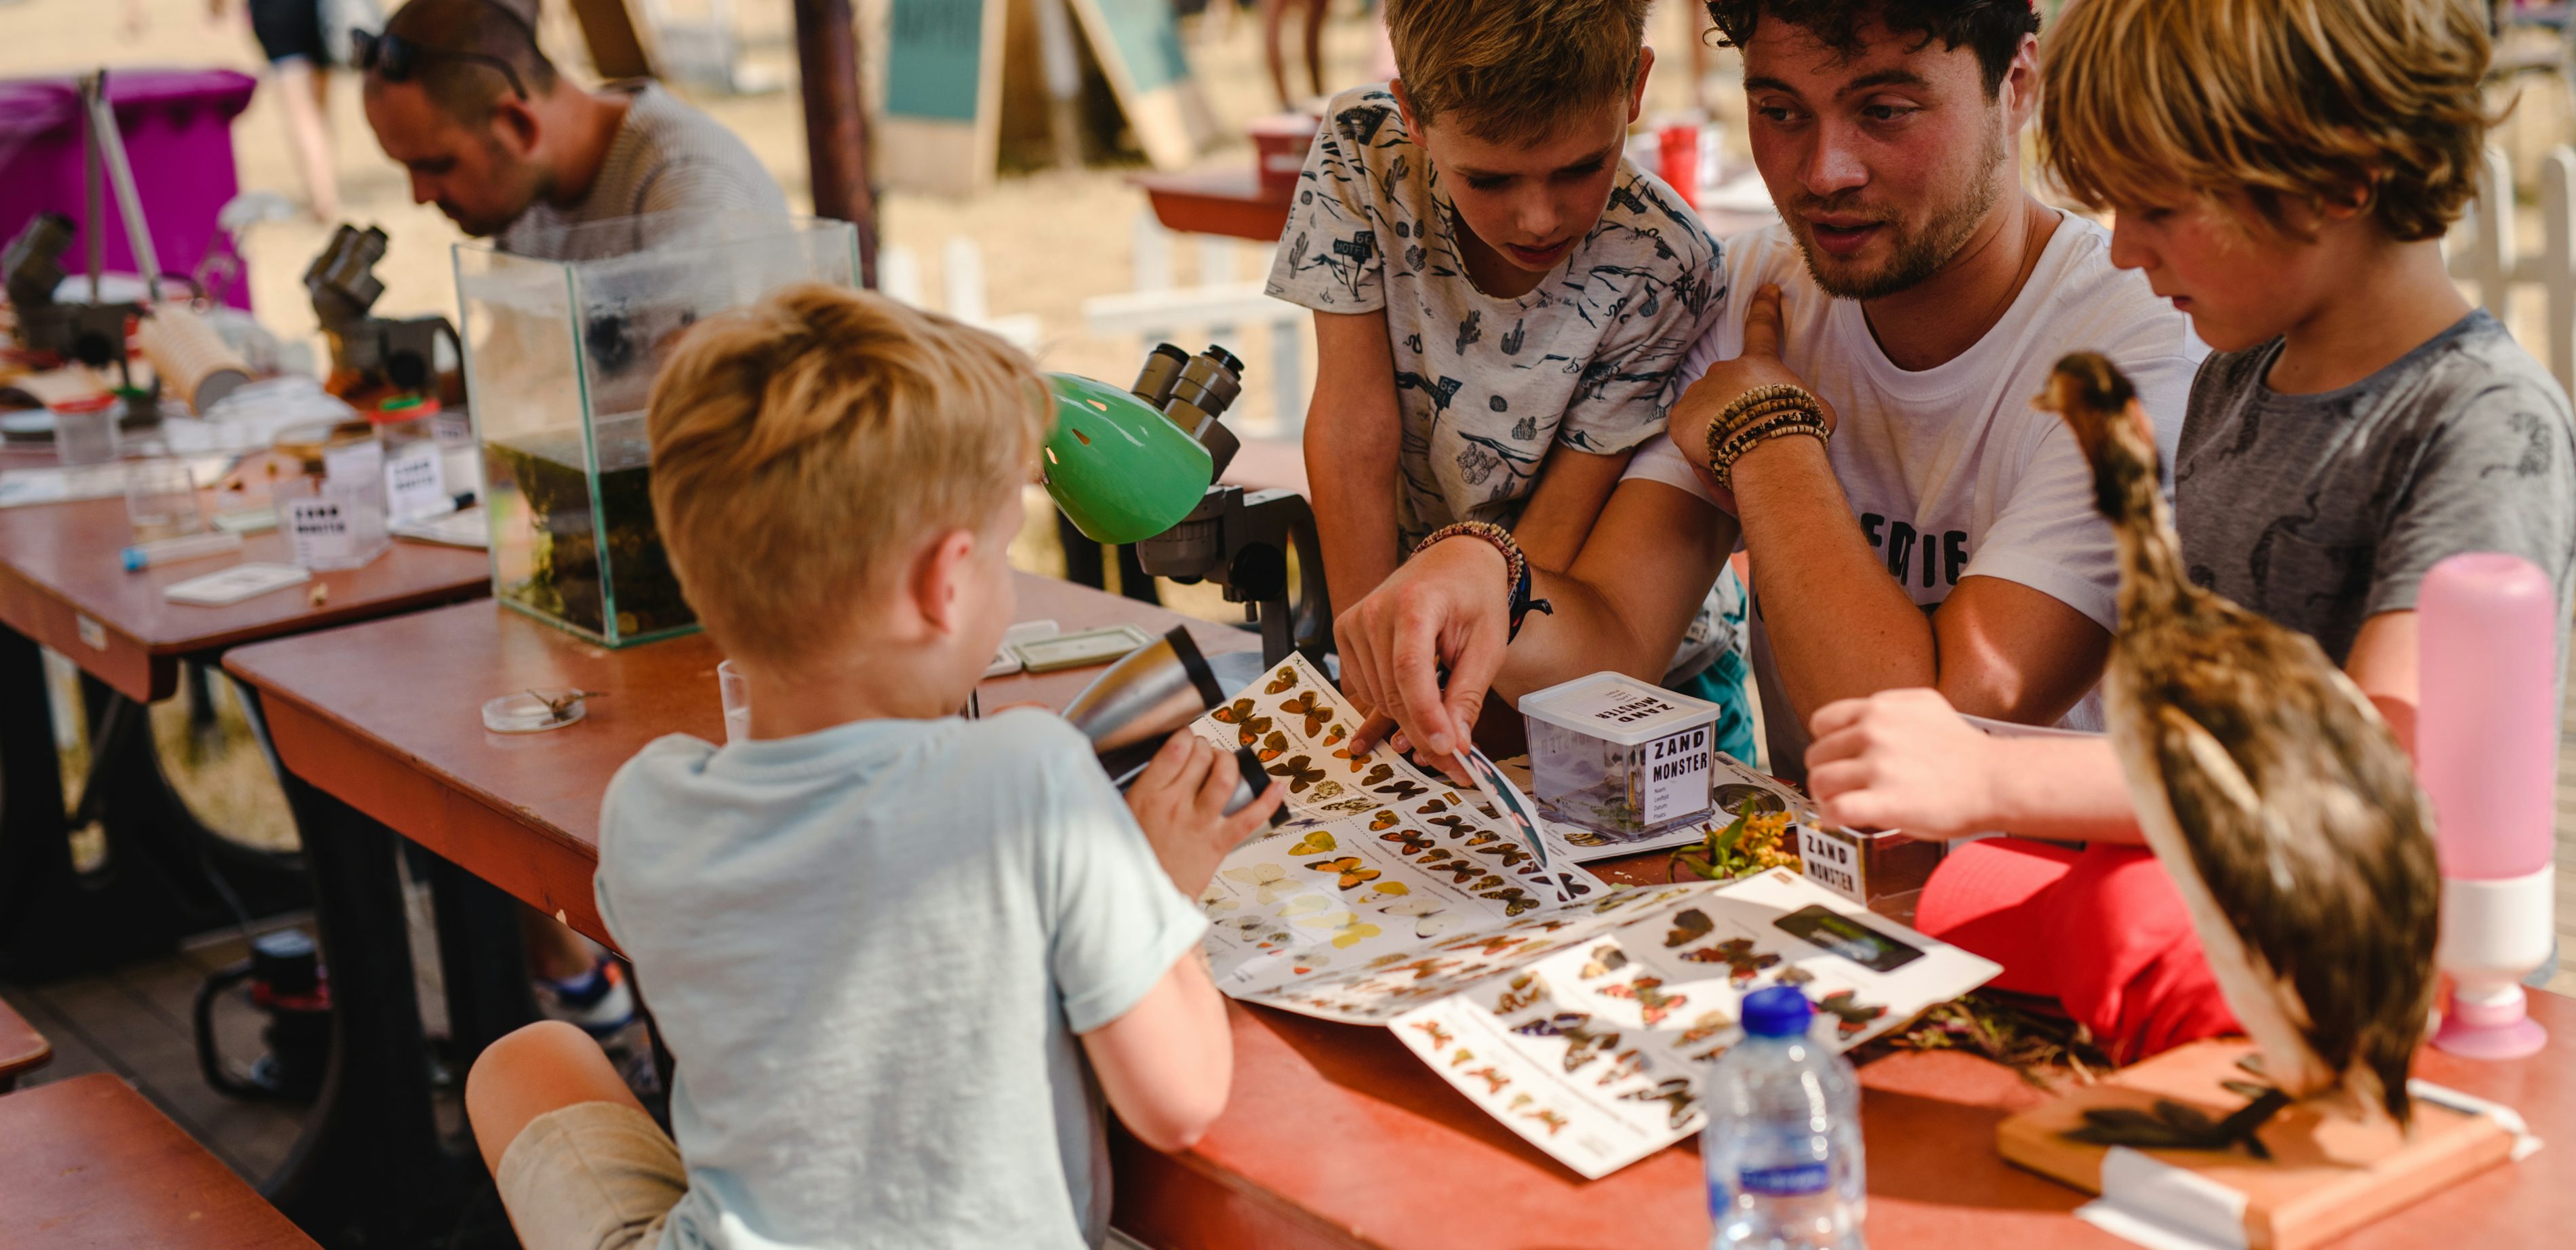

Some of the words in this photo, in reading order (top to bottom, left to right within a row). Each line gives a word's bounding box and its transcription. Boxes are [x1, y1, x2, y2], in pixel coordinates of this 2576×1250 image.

[1441, 378, 1455, 395] 66
[1595, 697, 1659, 719] MONSTER
[1618, 704, 1674, 722] ZAND
[1655, 731, 1704, 759] ZAND
[1653, 752, 1707, 782] MONSTER
[1807, 834, 1847, 864] ZAND
[1808, 860, 1853, 892] MONSTER
